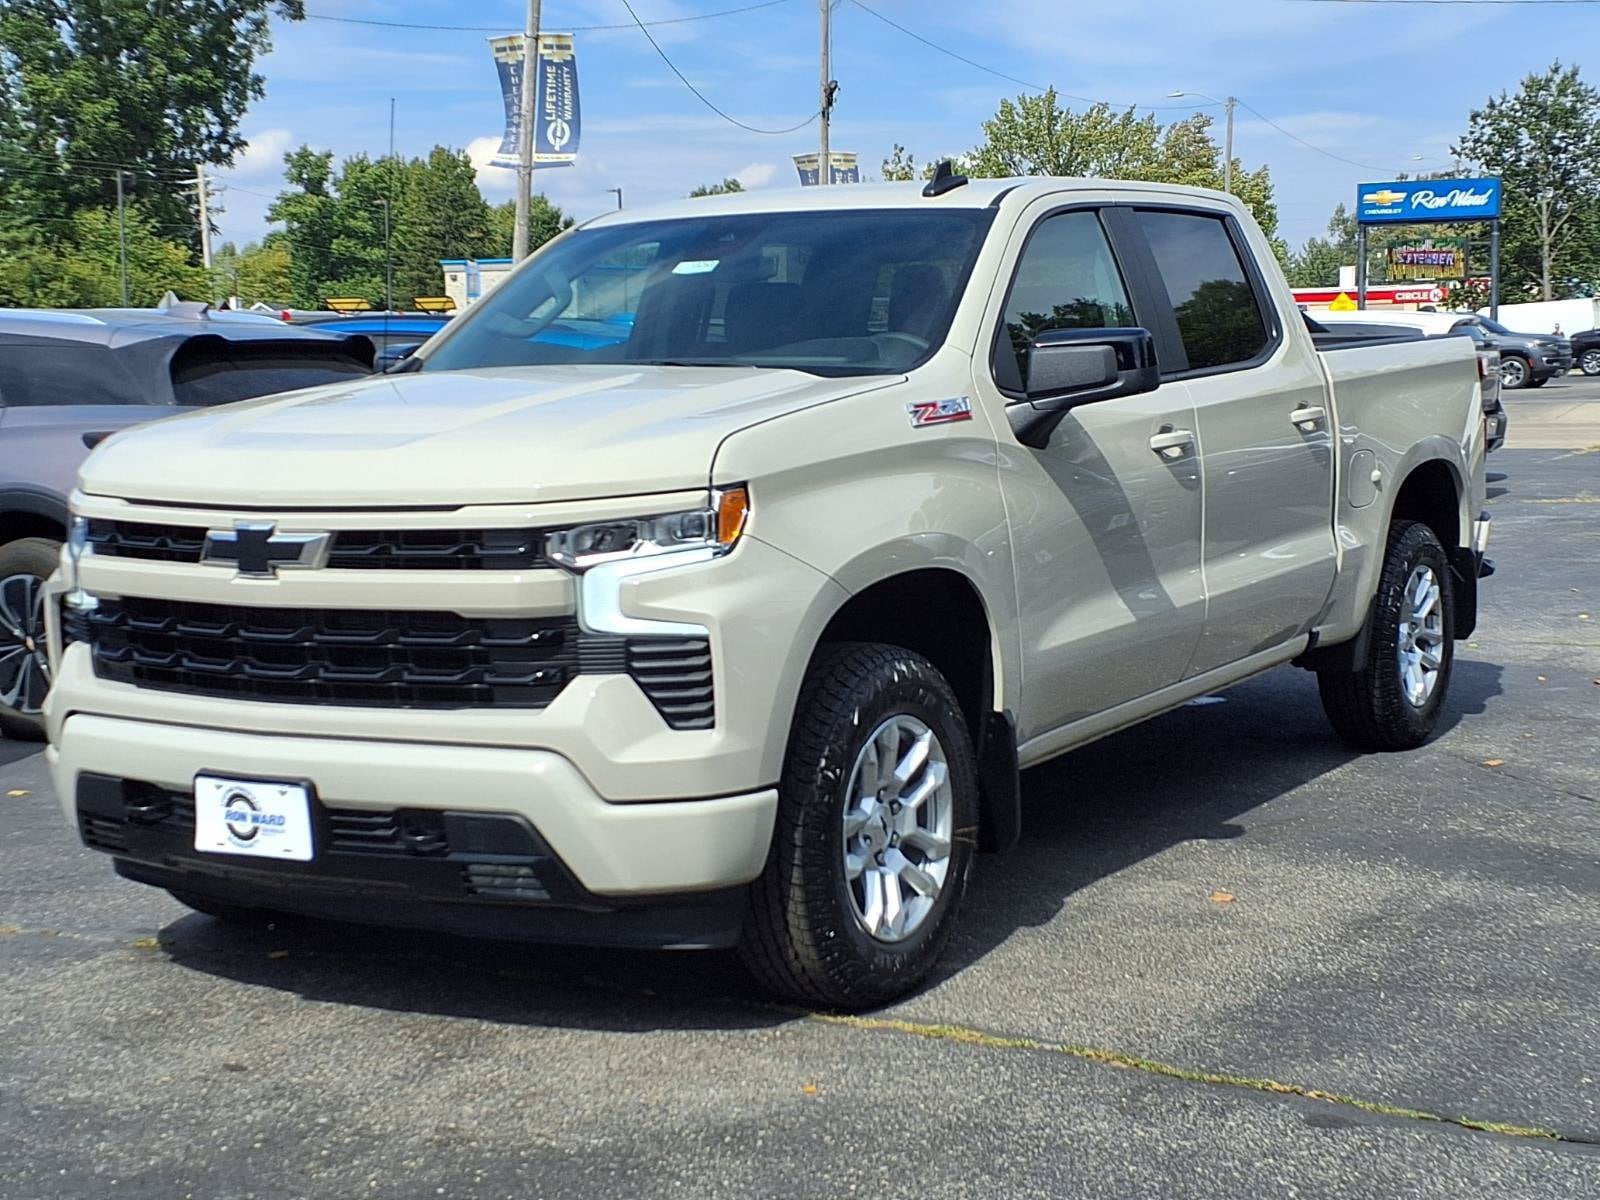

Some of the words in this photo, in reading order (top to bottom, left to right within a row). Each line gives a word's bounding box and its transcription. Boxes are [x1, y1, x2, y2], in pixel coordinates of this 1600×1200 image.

[544, 65, 556, 120] LIFETIME
[562, 66, 573, 120] WARRANTY
[1411, 190, 1447, 209] Ron
[1395, 291, 1429, 301] CIRCLE
[906, 395, 972, 428] Z71
[225, 810, 247, 822] RON
[251, 814, 286, 826] WARD
